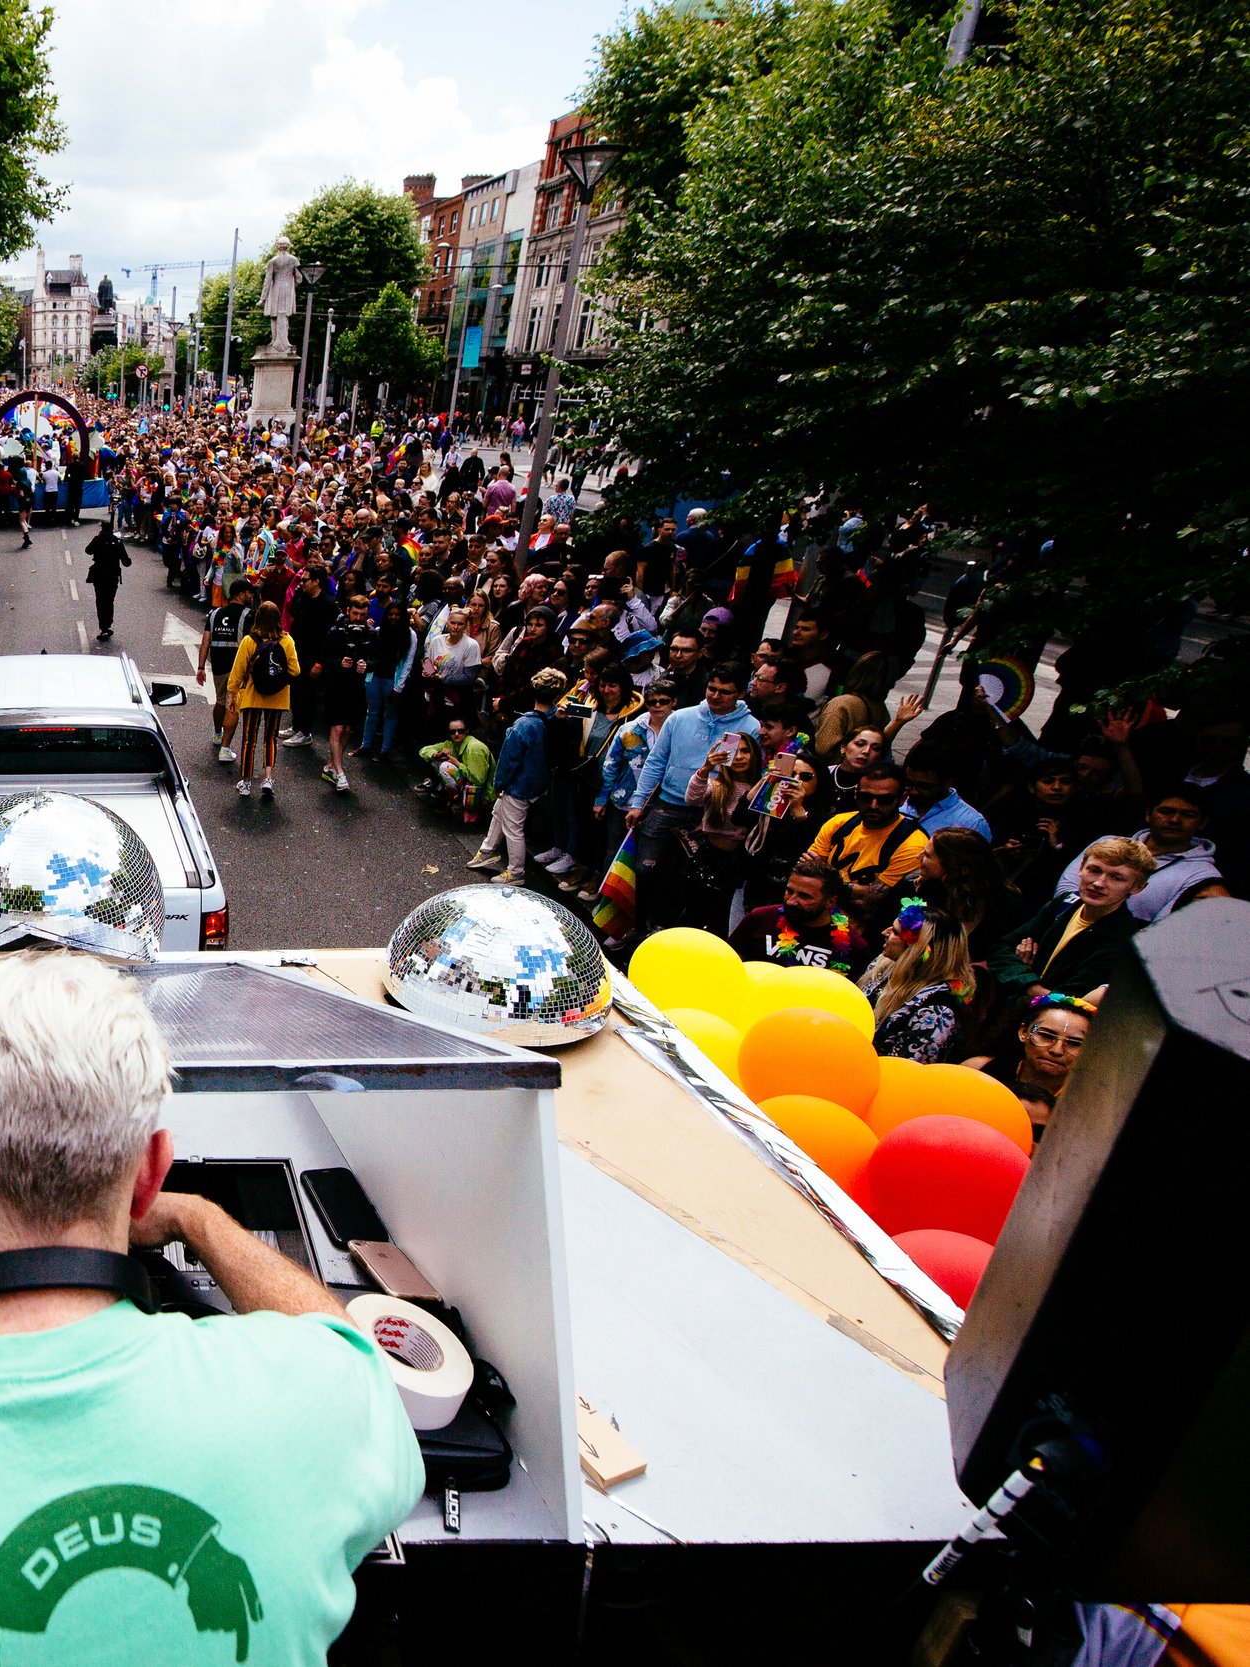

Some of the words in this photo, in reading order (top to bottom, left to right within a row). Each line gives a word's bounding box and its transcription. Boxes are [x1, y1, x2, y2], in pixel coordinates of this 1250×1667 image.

[765, 934, 832, 968] VNS
[449, 1490, 460, 1530] UDG
[21, 1512, 162, 1591] DEUS
